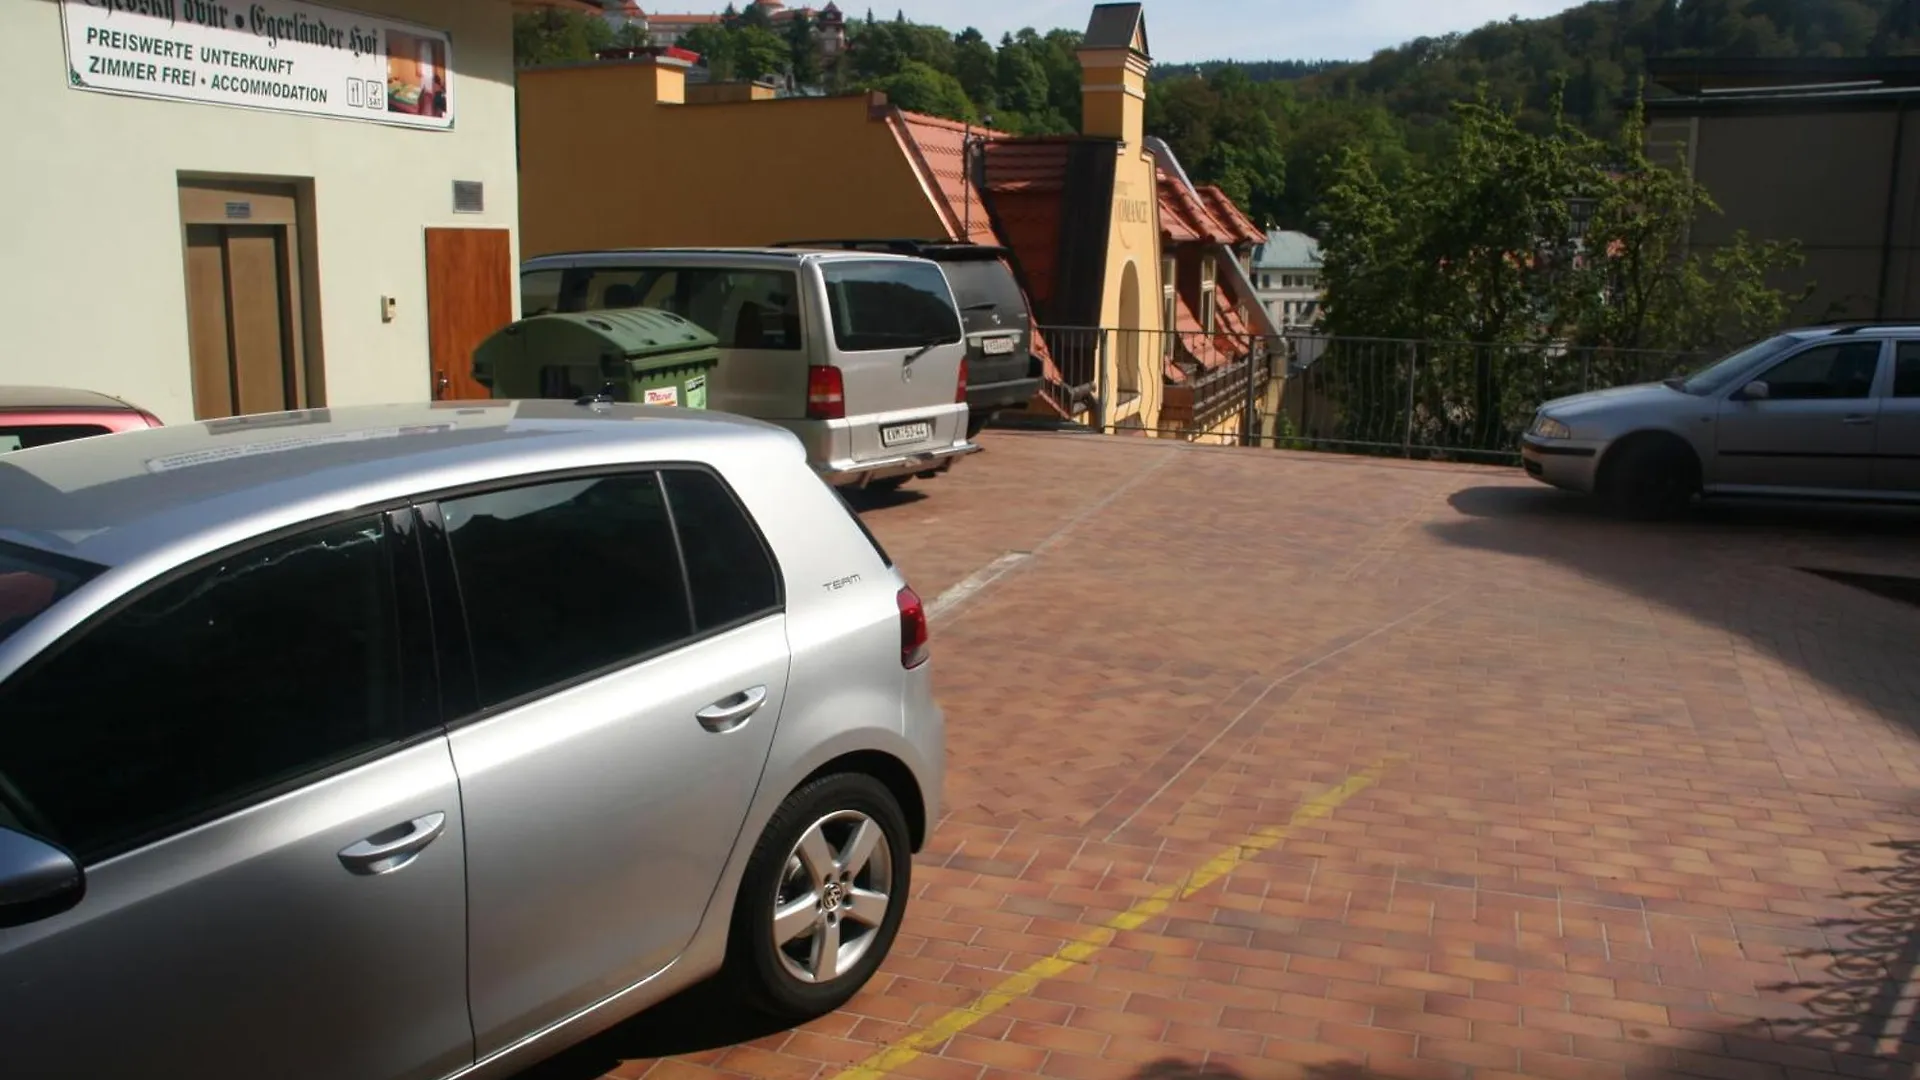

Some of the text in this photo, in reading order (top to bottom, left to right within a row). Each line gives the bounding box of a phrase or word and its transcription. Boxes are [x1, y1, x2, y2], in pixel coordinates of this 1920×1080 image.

[86, 27, 294, 76] PREISWERTE UNTERKUNFT
[88, 56, 328, 104] ZIMMER FREI ACCOMMODATION
